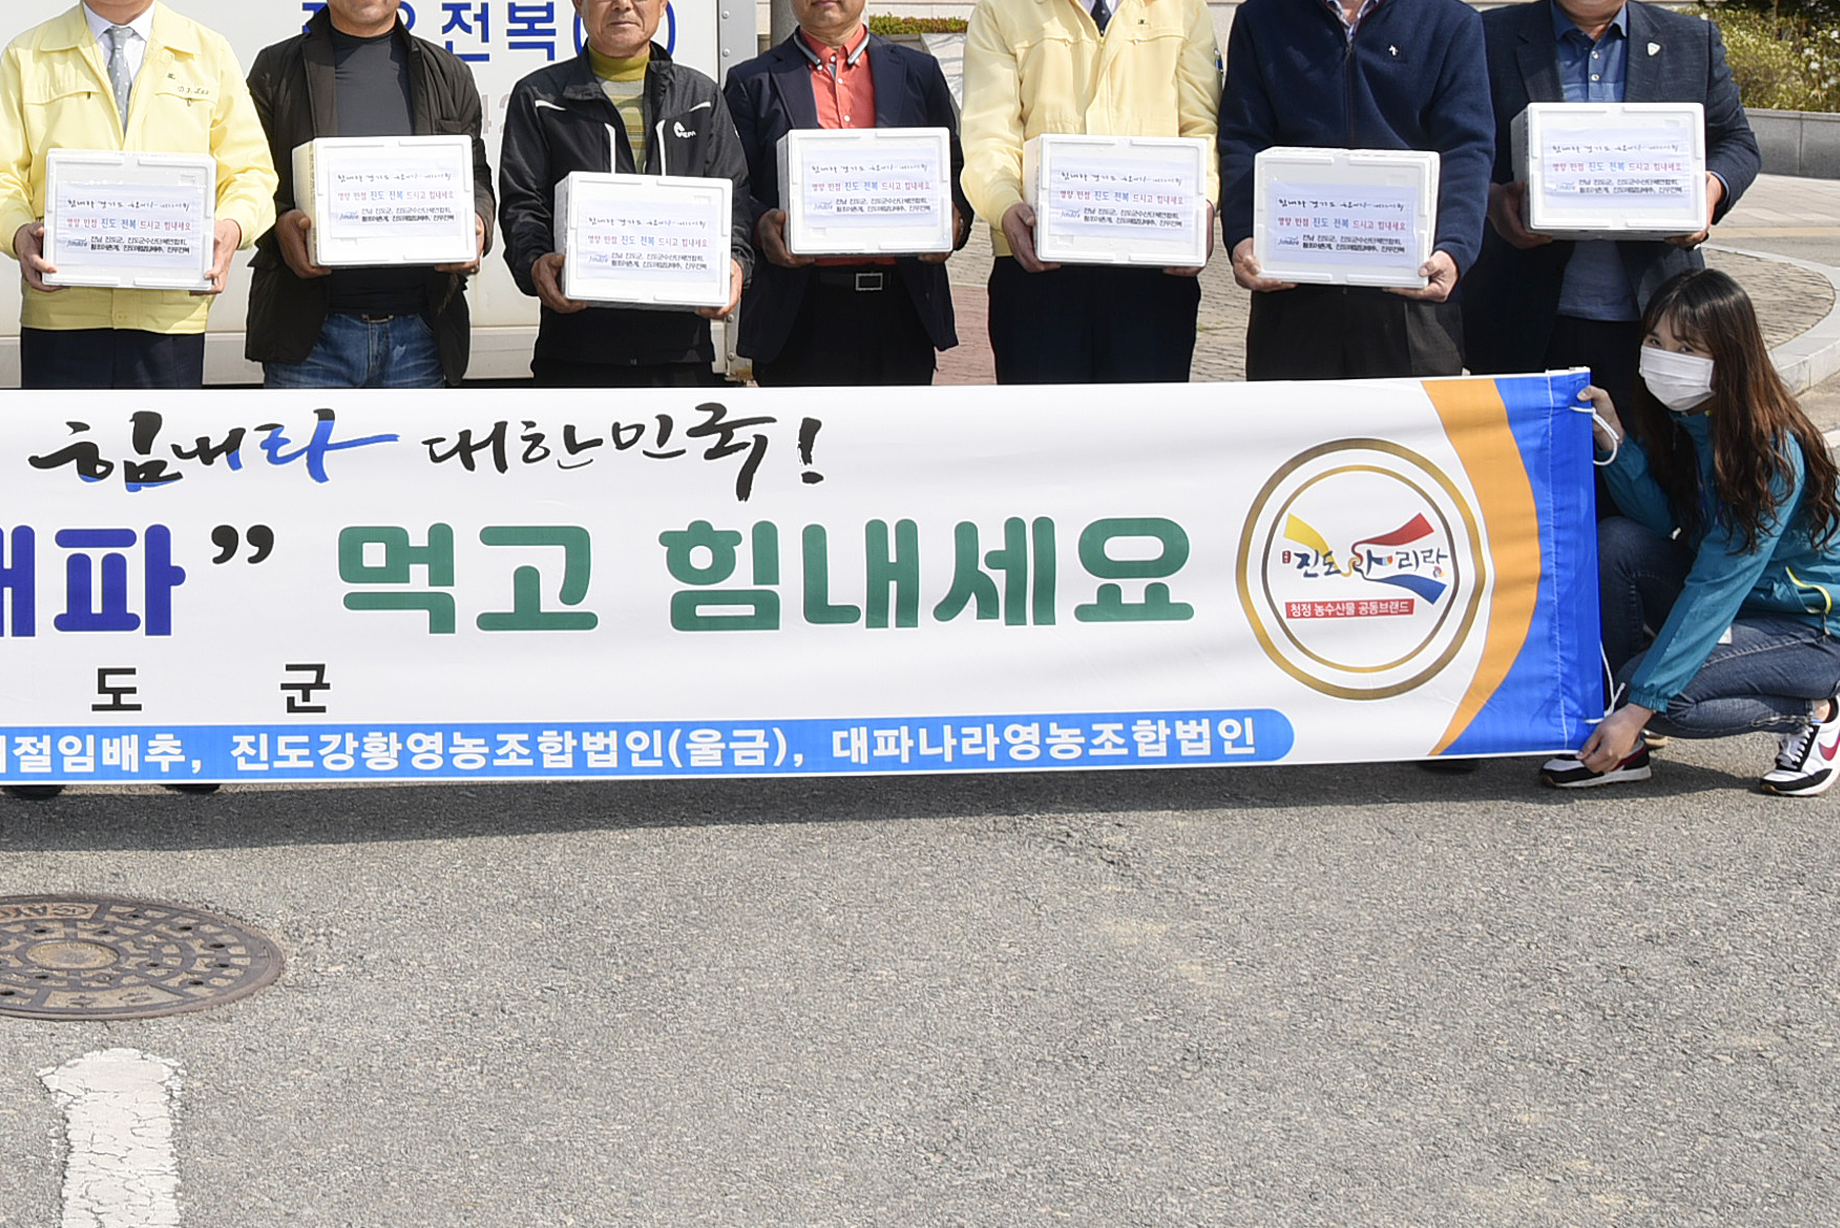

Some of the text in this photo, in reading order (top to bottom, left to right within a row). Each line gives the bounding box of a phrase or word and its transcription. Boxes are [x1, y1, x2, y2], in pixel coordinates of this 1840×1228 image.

[100, 217, 117, 228] 진도
[1312, 216, 1329, 228] 진도
[1332, 217, 1349, 228] 전복
[1352, 219, 1374, 229] 드시고
[27, 408, 400, 493] 힘내라
[421, 402, 824, 502] 대한민국!
[338, 523, 598, 634] 먹고
[659, 516, 1193, 632] 힘내세요
[832, 716, 1257, 765] 대파나라영농조합법인
